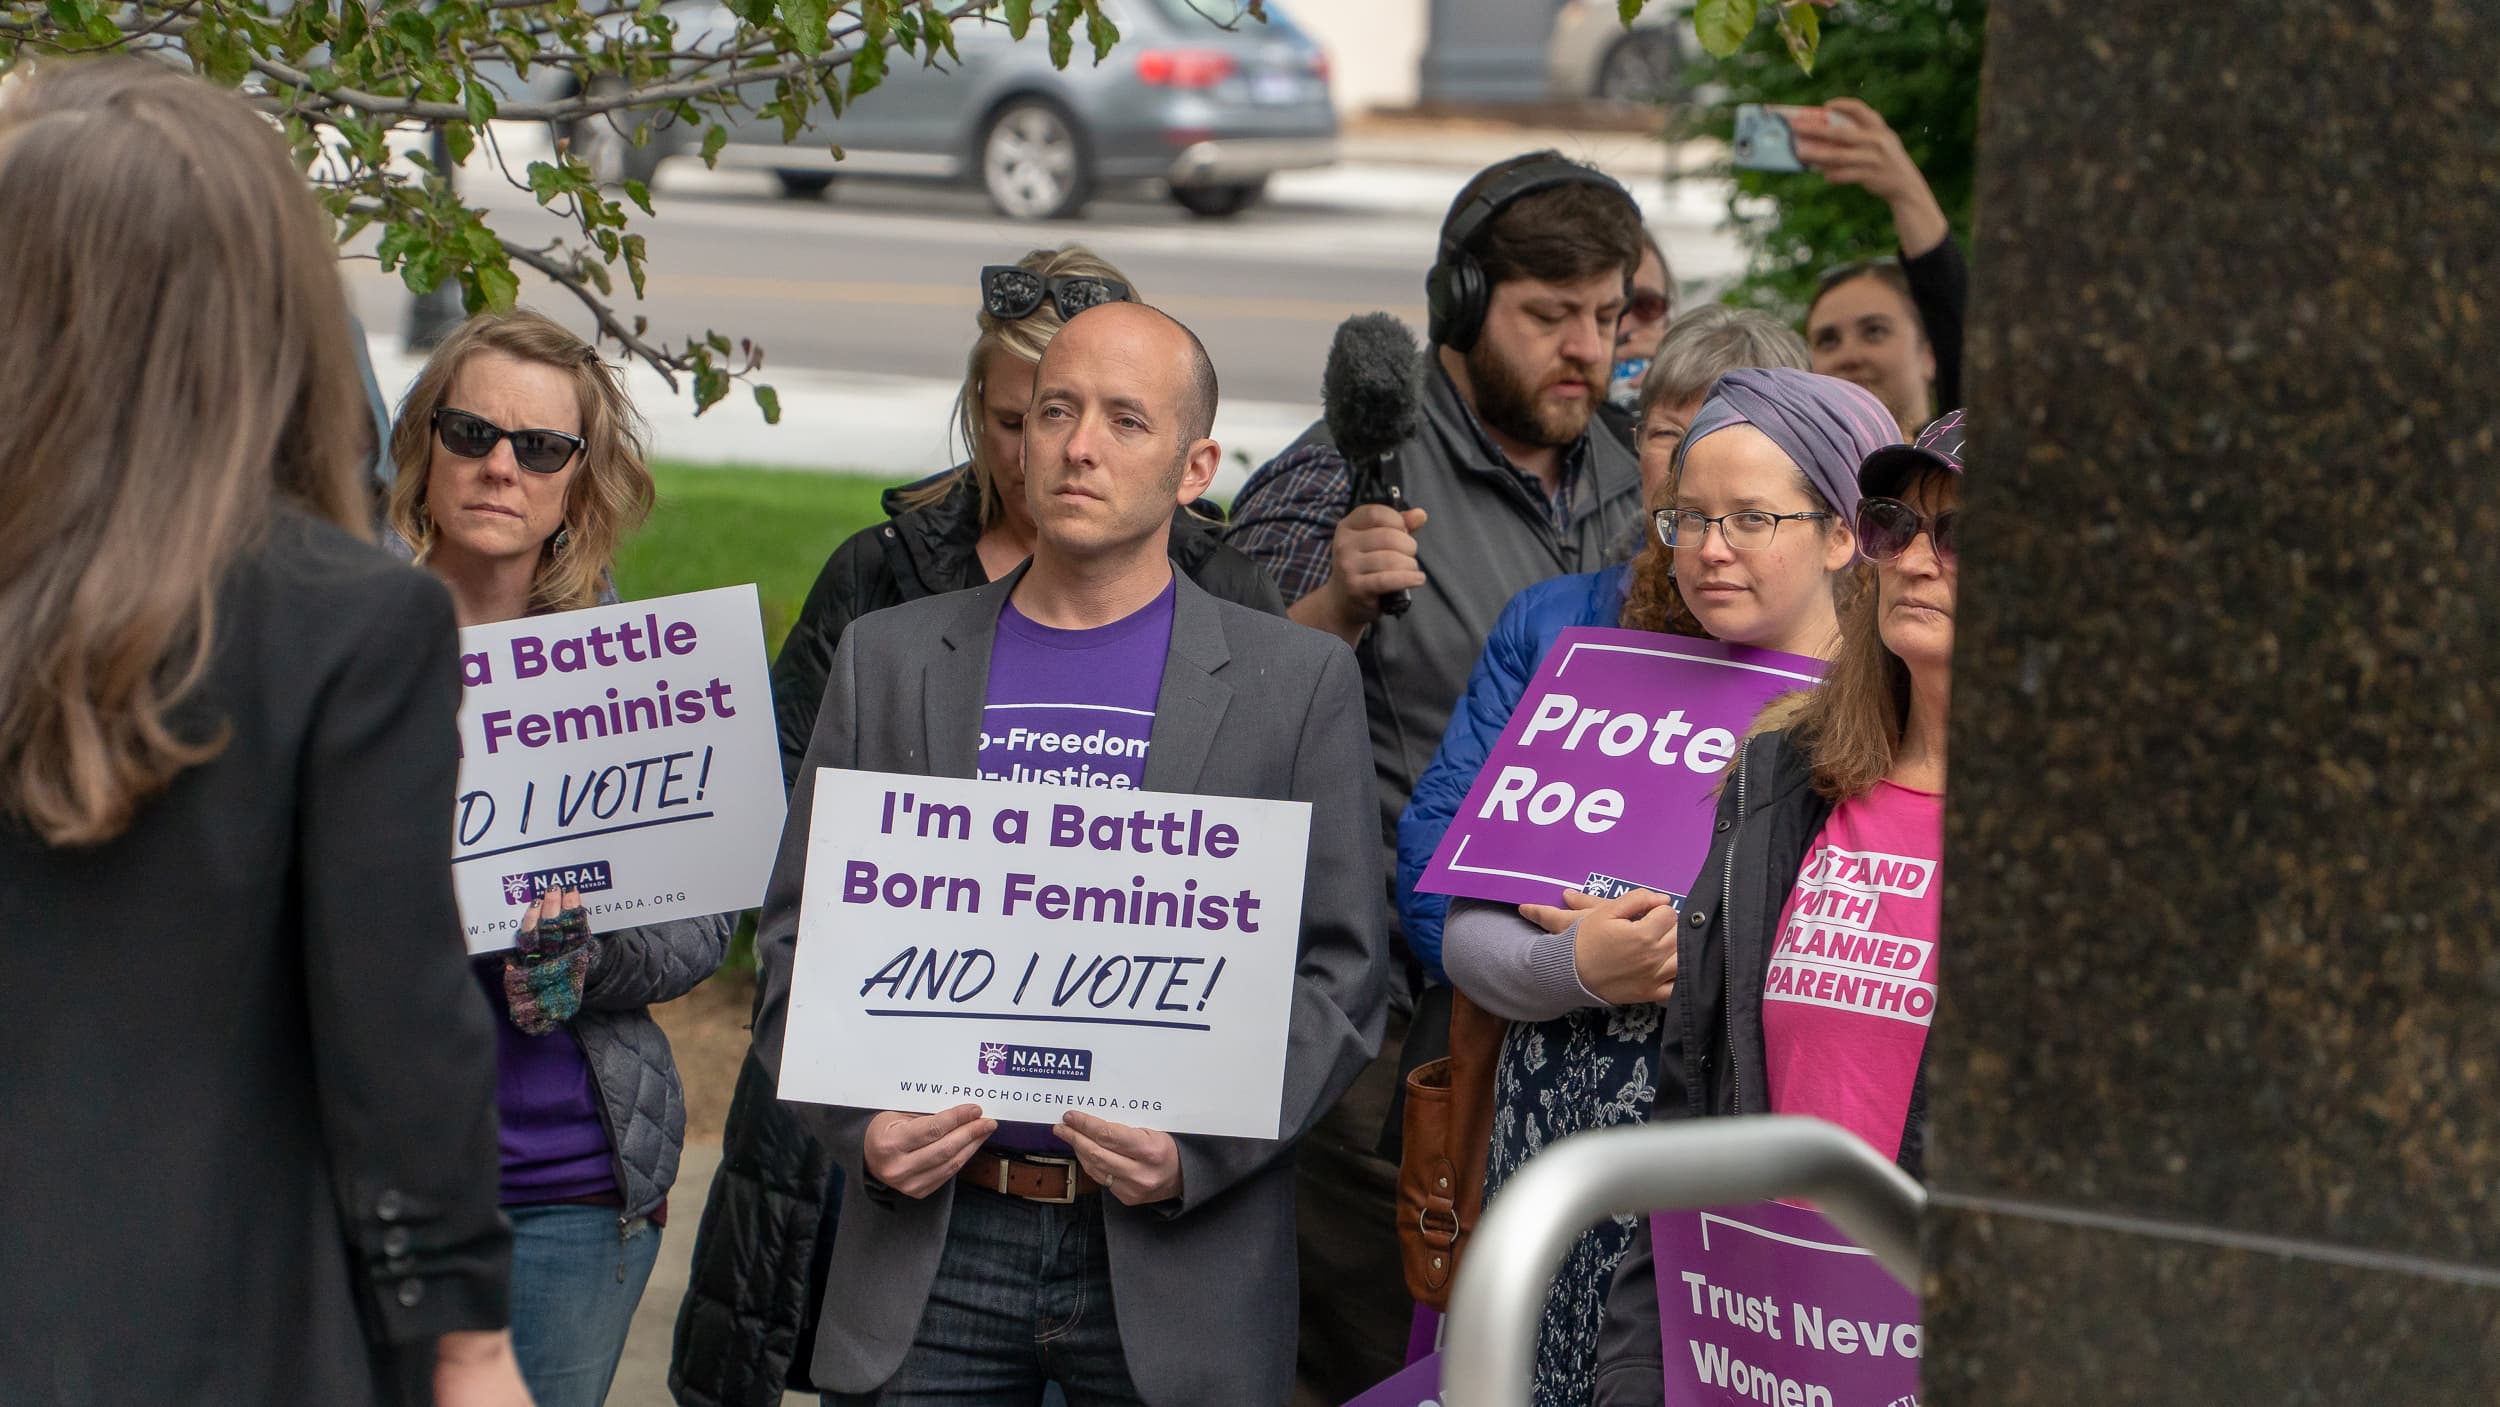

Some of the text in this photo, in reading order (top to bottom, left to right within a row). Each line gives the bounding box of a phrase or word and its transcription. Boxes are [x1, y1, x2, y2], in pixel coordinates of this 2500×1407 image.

[510, 614, 697, 679] Battle
[483, 678, 736, 754] Feminist
[519, 781, 535, 834] I
[558, 745, 713, 827] VOTE!
[1478, 765, 1625, 834] Roe
[880, 791, 1240, 859] I'm a Battle
[534, 866, 605, 890] NARAL
[842, 859, 1261, 934] Born Feminist
[1824, 850, 1925, 890] STAND
[1795, 886, 1873, 924] WITH
[859, 946, 1226, 1012] AND I VOTE!
[1780, 926, 1921, 970] PLANNED
[1765, 966, 1934, 1017] PARENTHO
[1012, 1051, 1085, 1070] NARAL
[1012, 1066, 1084, 1077] PRO-CHOICE NEVADA
[900, 1081, 1163, 1111] WWW.PROCHOICENEVADA.ORG
[1681, 1271, 1781, 1340] Trust
[1689, 1340, 1832, 1407] Women
